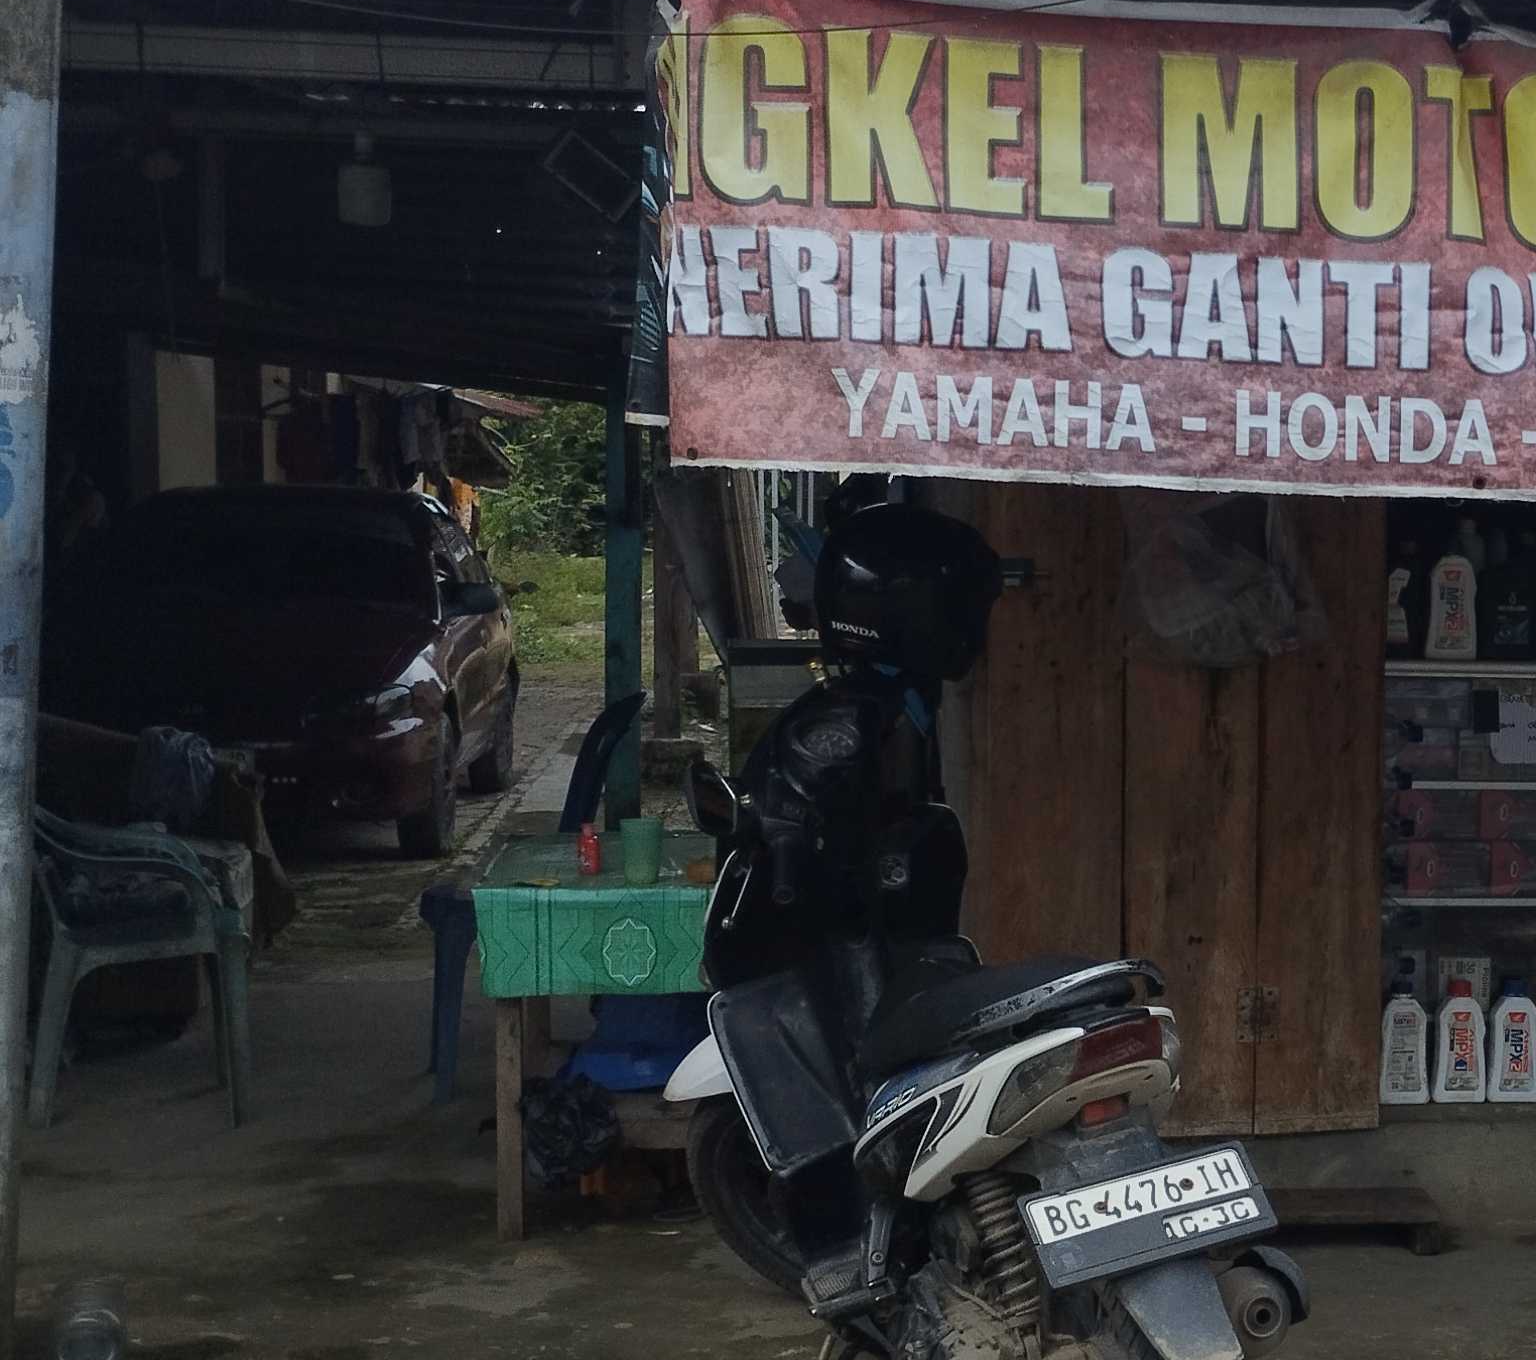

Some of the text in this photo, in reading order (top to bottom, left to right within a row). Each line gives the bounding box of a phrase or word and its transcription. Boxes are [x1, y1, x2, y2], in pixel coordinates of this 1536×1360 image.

[1101, 247, 1431, 371] GANTI
[831, 367, 1156, 453] YAMAHA
[1182, 416, 1207, 432] -
[1235, 389, 1497, 465] HONDA
[831, 620, 880, 639] HONDA
[1510, 1029, 1524, 1073] MPX2
[867, 1085, 916, 1129] VARIO
[1044, 1157, 1239, 1237] BG 4476 IH
